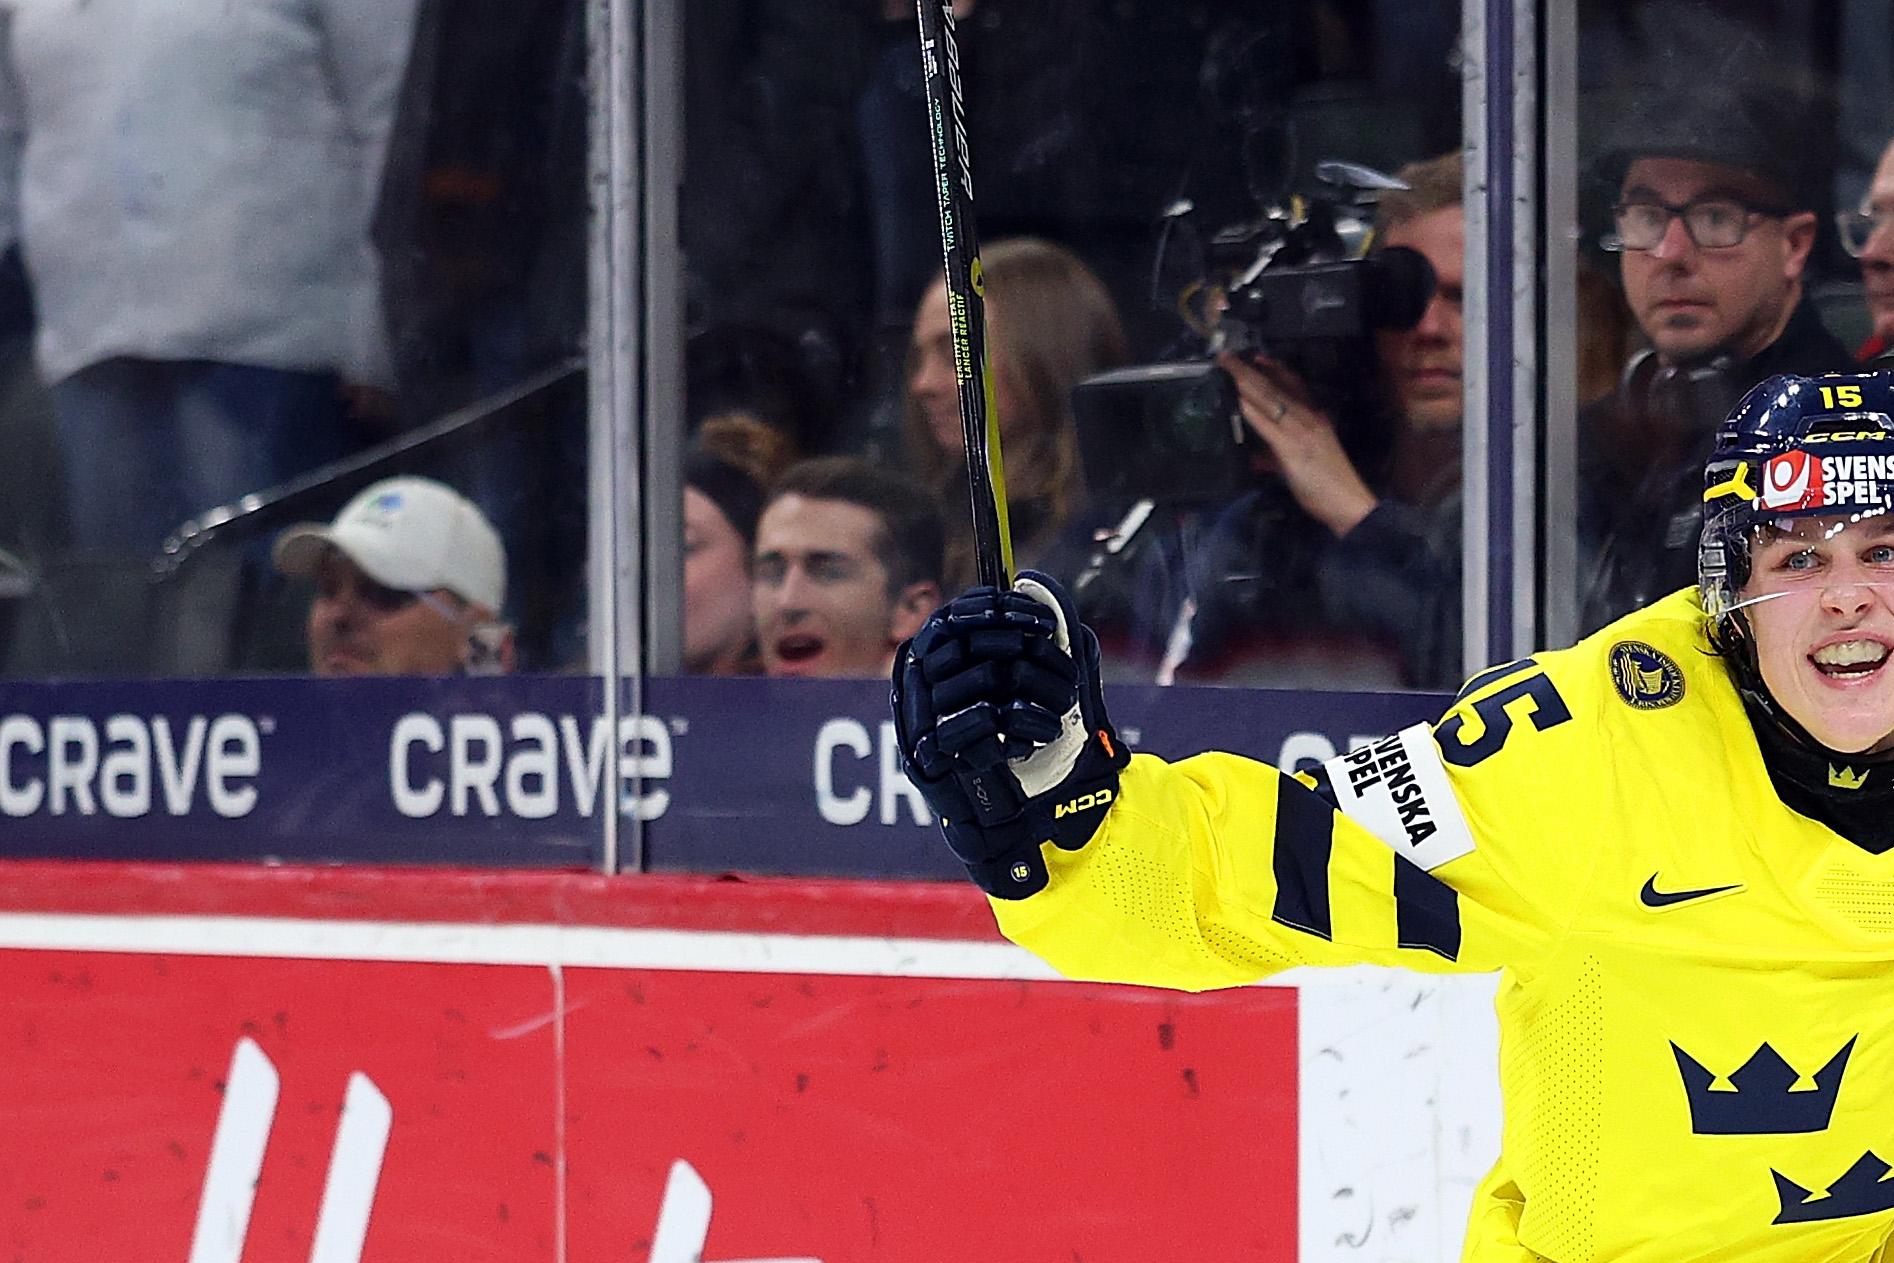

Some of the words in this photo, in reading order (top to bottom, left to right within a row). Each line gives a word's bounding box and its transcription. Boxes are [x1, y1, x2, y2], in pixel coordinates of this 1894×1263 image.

[1818, 384, 1864, 410] 15
[1803, 430, 1887, 444] CCM
[1821, 480, 1884, 507] SPEL
[1343, 745, 1382, 799] PEL
[1054, 787, 1113, 820] CCM
[1374, 734, 1438, 848] VENSKA
[1013, 865, 1029, 879] 15
